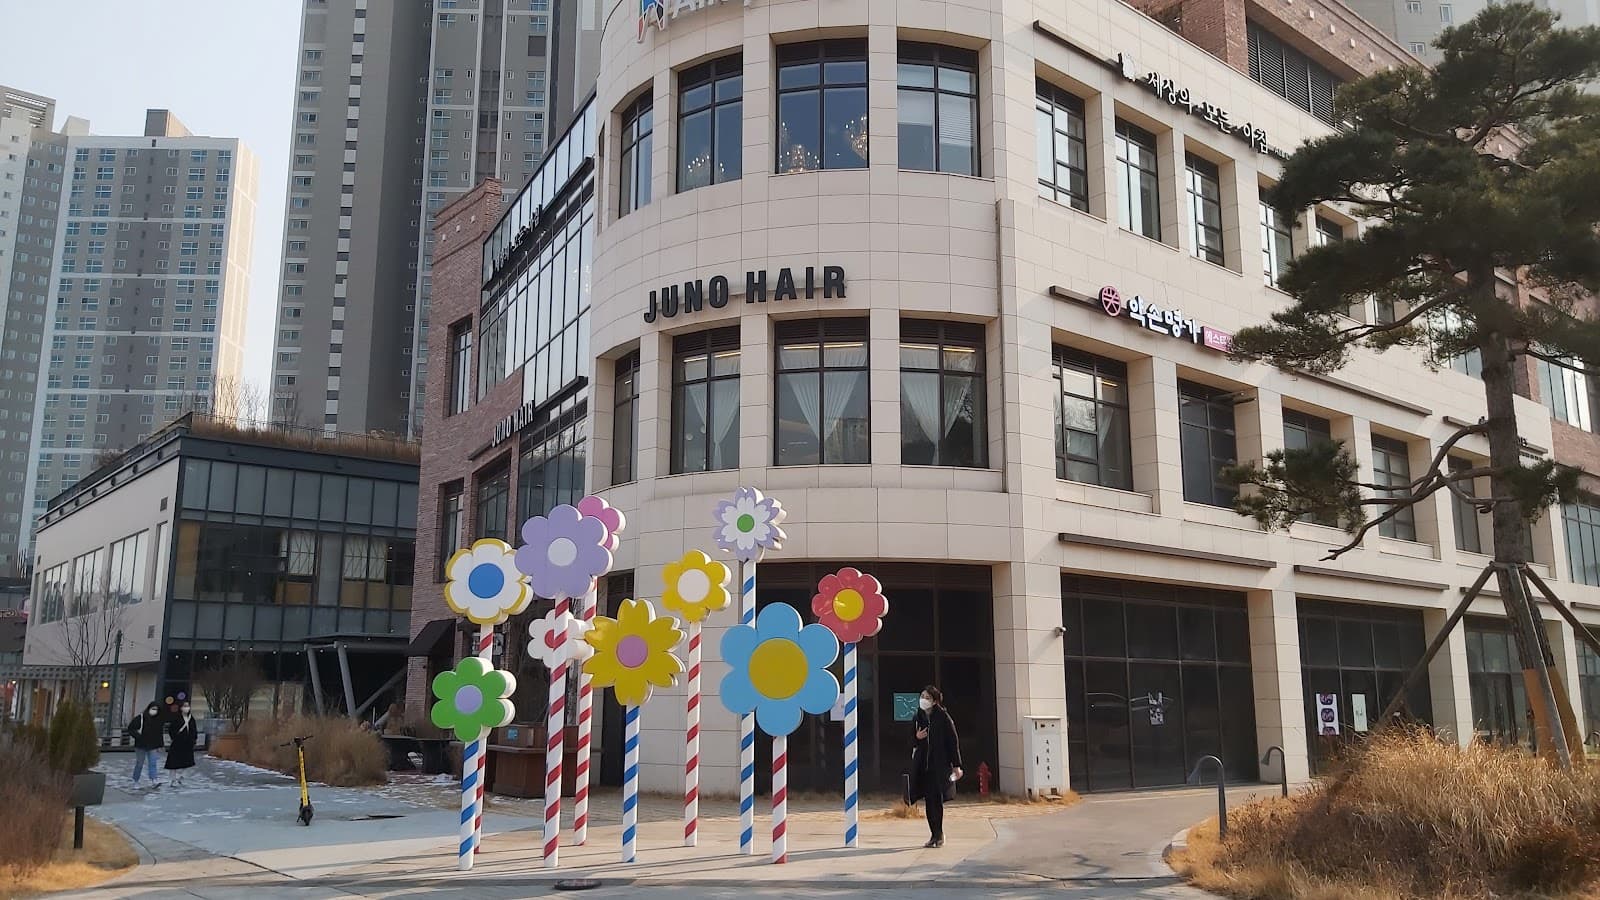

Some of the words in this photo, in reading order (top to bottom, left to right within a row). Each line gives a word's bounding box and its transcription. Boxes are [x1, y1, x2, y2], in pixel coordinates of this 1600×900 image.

[1147, 71, 1193, 115] 세상의
[1202, 100, 1231, 134] 모든
[1243, 121, 1269, 155] 아침
[643, 275, 729, 324] JUNO
[745, 265, 847, 304] HAIR
[1126, 295, 1201, 344] 약손명가
[491, 415, 513, 448] JUNO
[513, 399, 535, 433] HAIR
